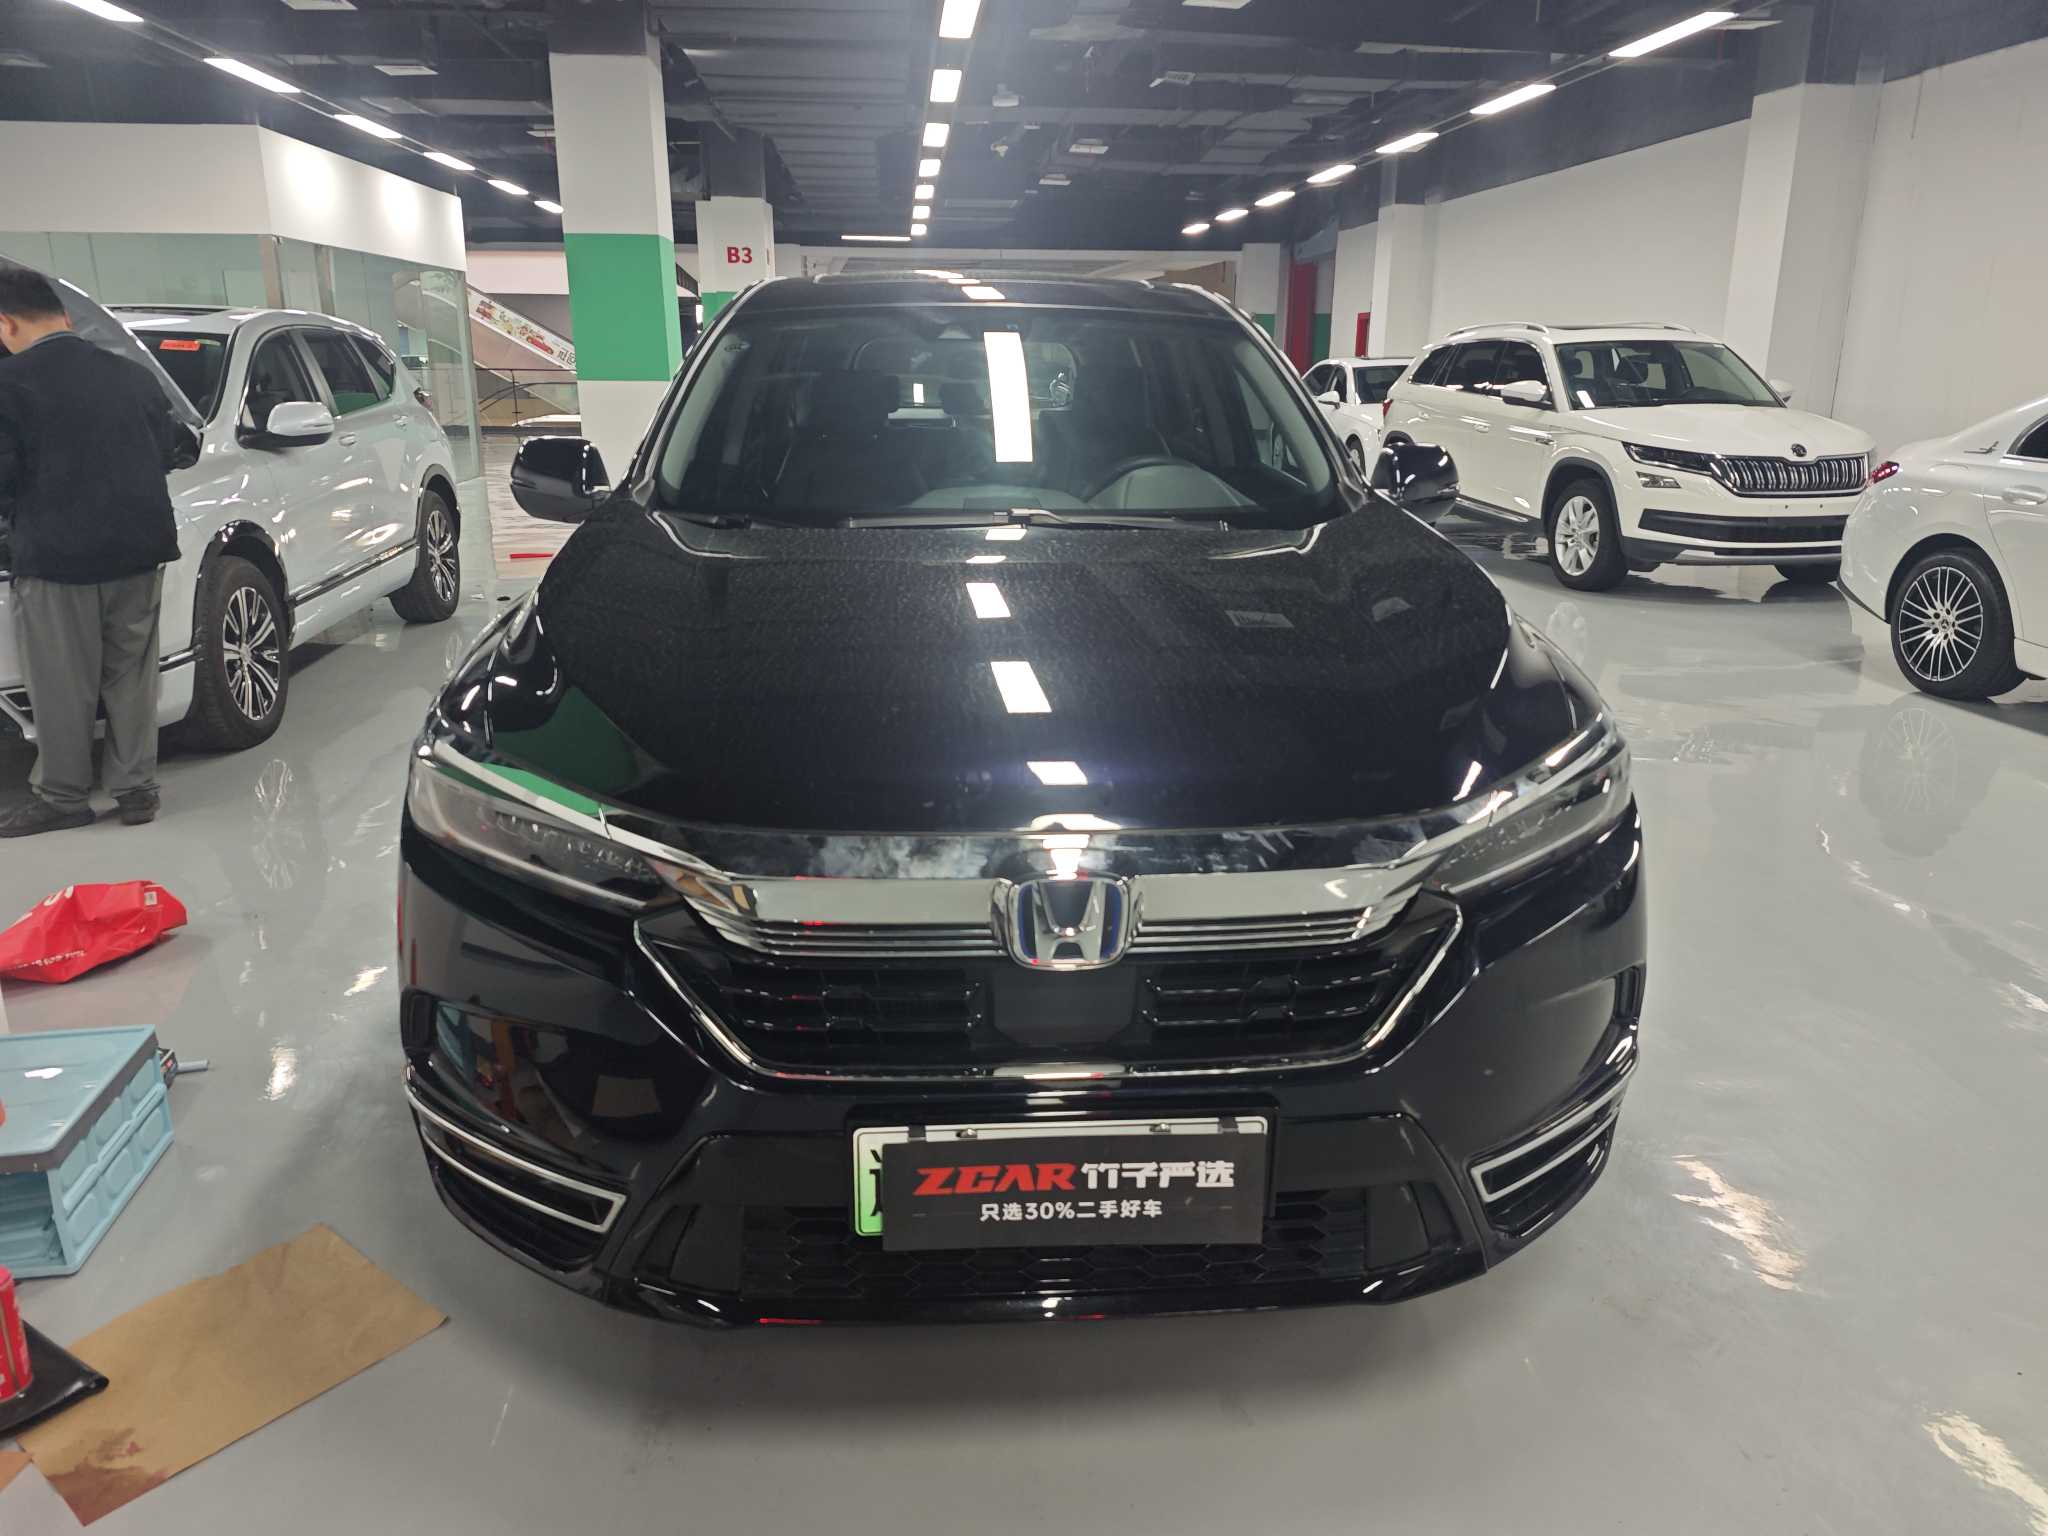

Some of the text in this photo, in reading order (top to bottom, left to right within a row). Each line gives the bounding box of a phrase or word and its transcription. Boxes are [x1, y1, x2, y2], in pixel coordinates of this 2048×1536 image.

[727, 246, 752, 263] B3
[913, 1162, 1076, 1196] ZCAR
[1081, 1160, 1235, 1190] 竹子严选
[979, 1199, 1163, 1223] 只选30%二手好车
